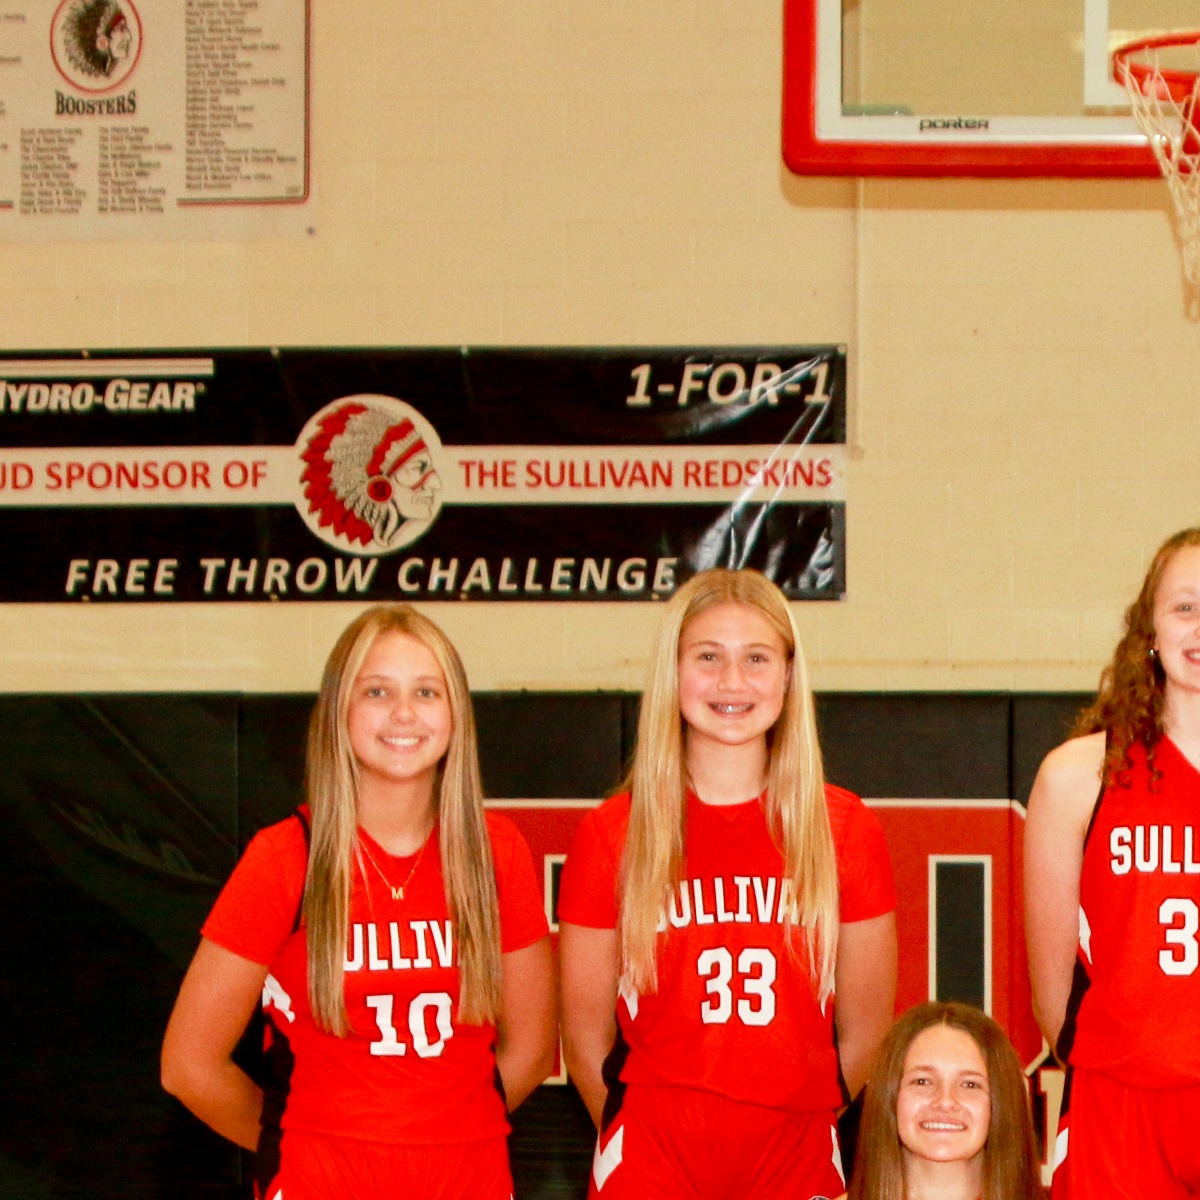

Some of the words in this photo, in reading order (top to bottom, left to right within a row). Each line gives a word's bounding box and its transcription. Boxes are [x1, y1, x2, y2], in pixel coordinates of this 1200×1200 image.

[54, 89, 136, 116] BOOSTERS
[626, 363, 831, 406] 1-FOR-1
[45, 461, 211, 490] SPONSOR
[223, 460, 267, 488] OF
[459, 460, 517, 488] THE
[525, 460, 673, 488] SULLIVAN
[683, 459, 832, 488] REDSKINS
[65, 558, 178, 594] FREE
[200, 557, 378, 594] THROW
[397, 557, 678, 592] CHALLENGE
[656, 874, 806, 933] ULLIVA
[697, 946, 776, 1026] 33
[366, 992, 454, 1058] 10
